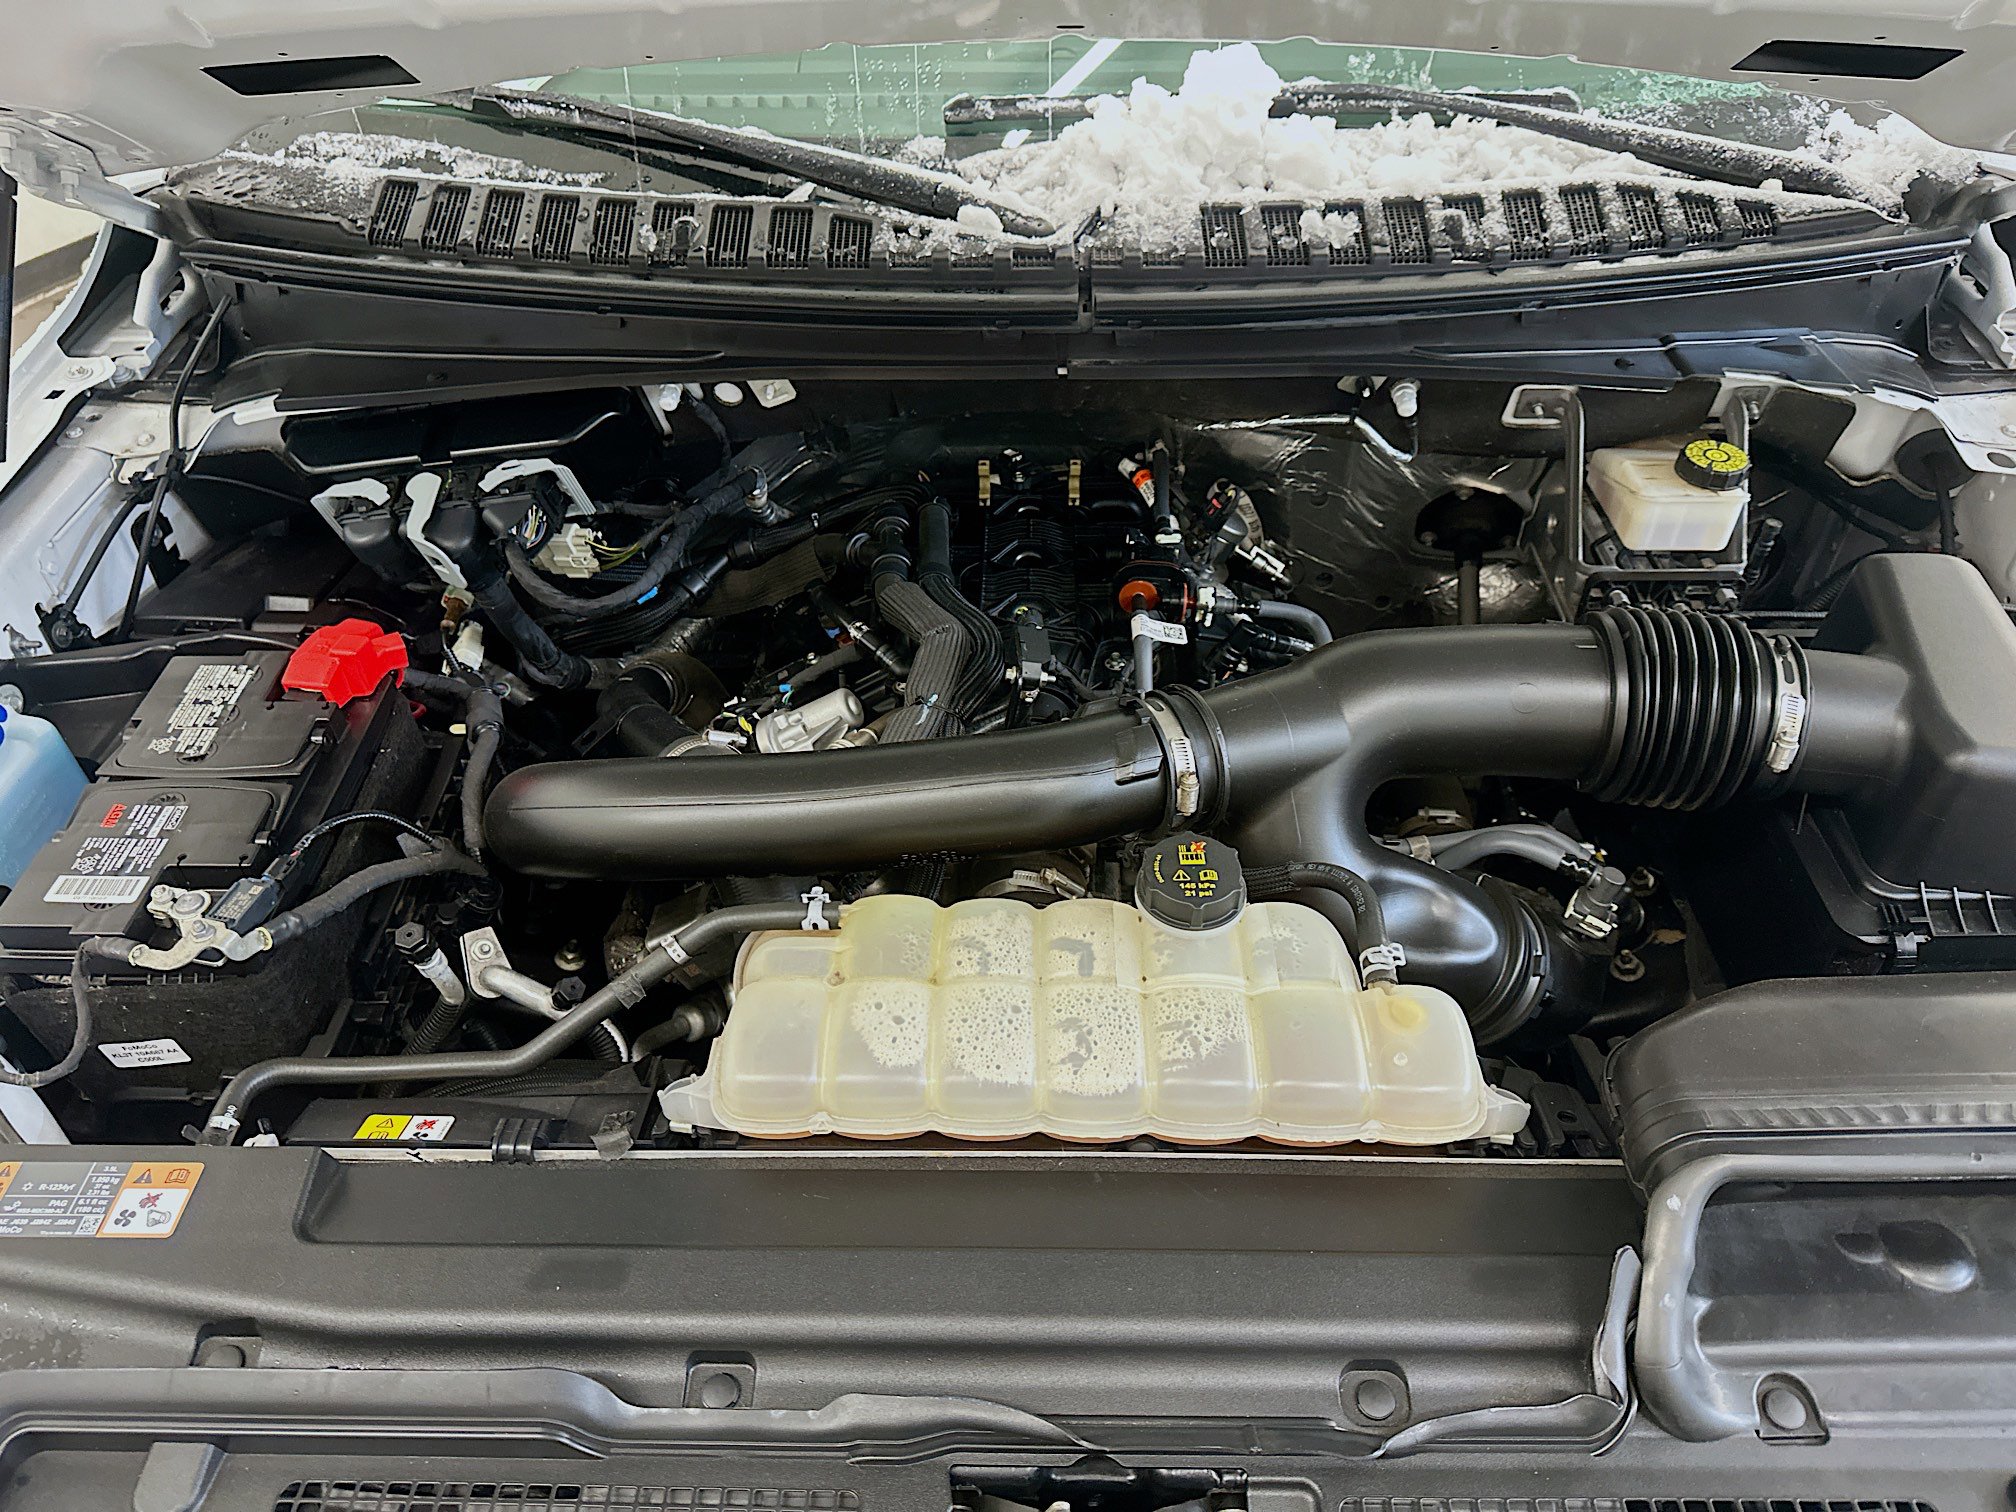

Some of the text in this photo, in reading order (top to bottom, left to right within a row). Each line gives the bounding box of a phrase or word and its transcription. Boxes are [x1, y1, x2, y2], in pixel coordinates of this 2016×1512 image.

[103, 803, 127, 828] AGM
[1199, 890, 1213, 898] psi
[110, 1176, 120, 1185] kg
[38, 1183, 77, 1192] R-1234yf
[48, 1199, 68, 1207] PAG
